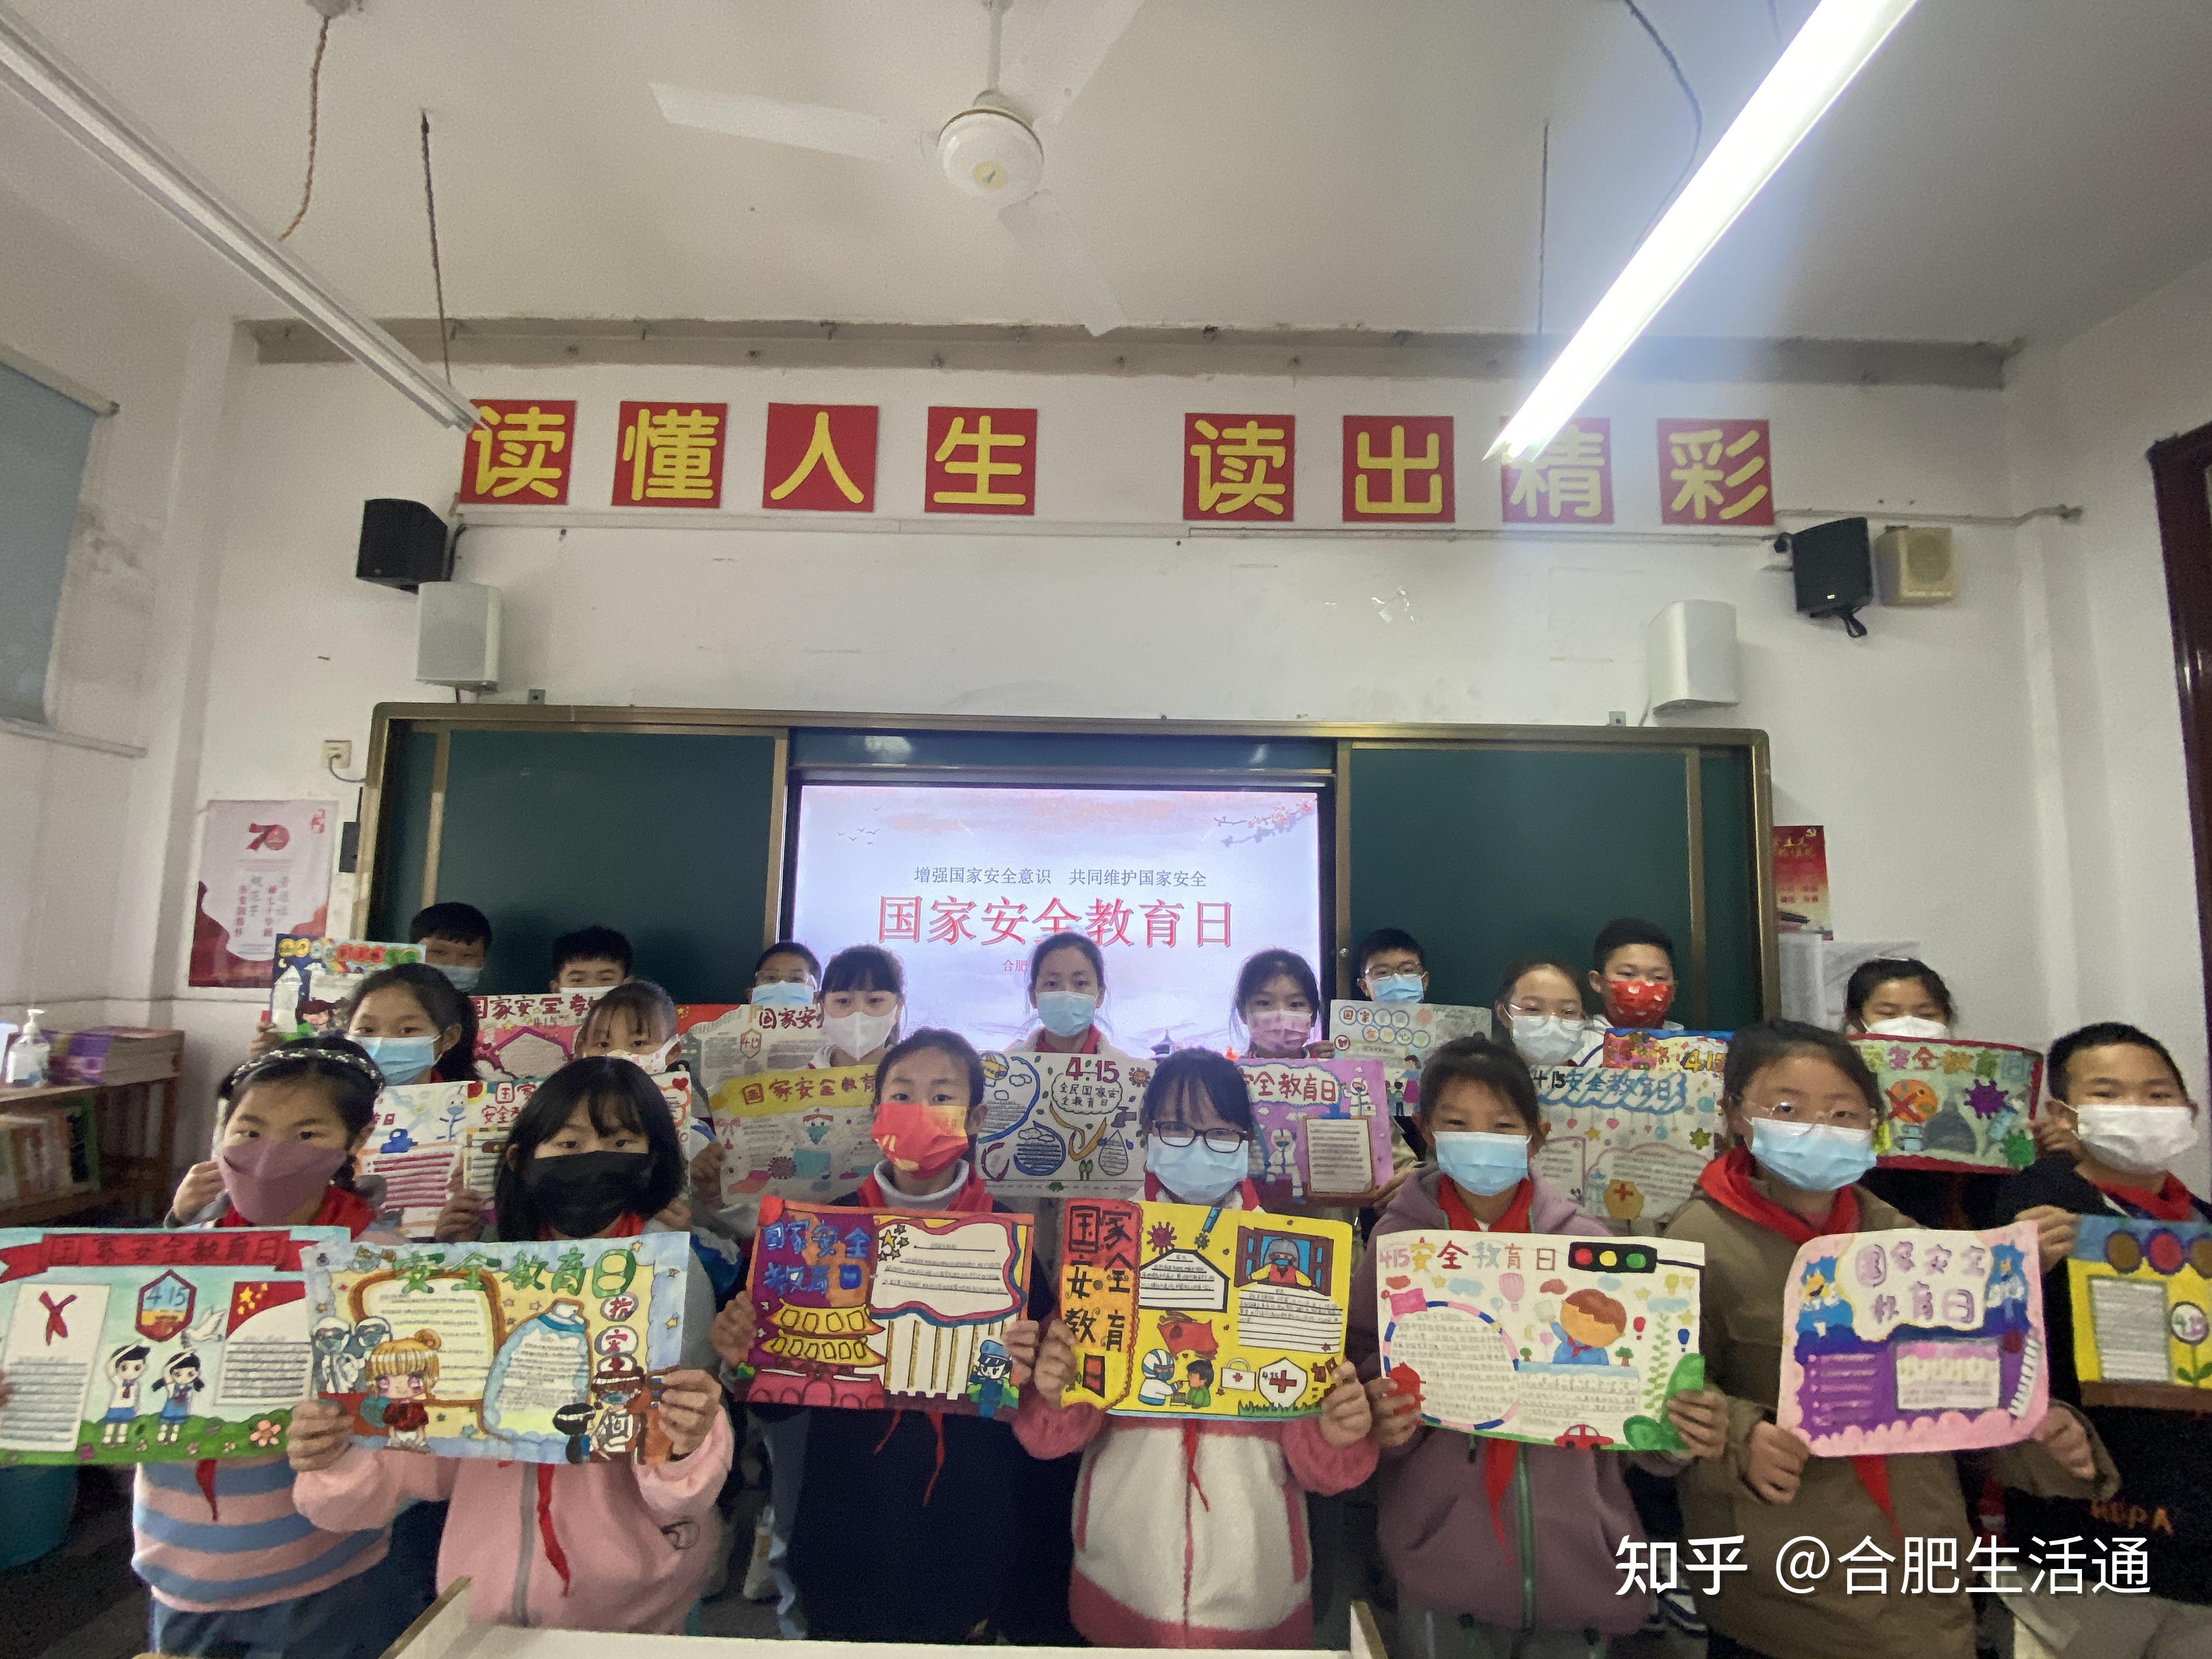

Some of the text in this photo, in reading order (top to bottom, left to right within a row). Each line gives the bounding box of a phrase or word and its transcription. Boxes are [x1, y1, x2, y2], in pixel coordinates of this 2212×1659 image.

[472, 405, 1768, 520] 读懂人生 读出精彩
[245, 821, 290, 851] 70
[914, 866, 1207, 888] 增强国家安全意识 共同维护国家安全
[878, 894, 1233, 948] 国家安全教育日
[1061, 1097, 1108, 1109] 全教育日
